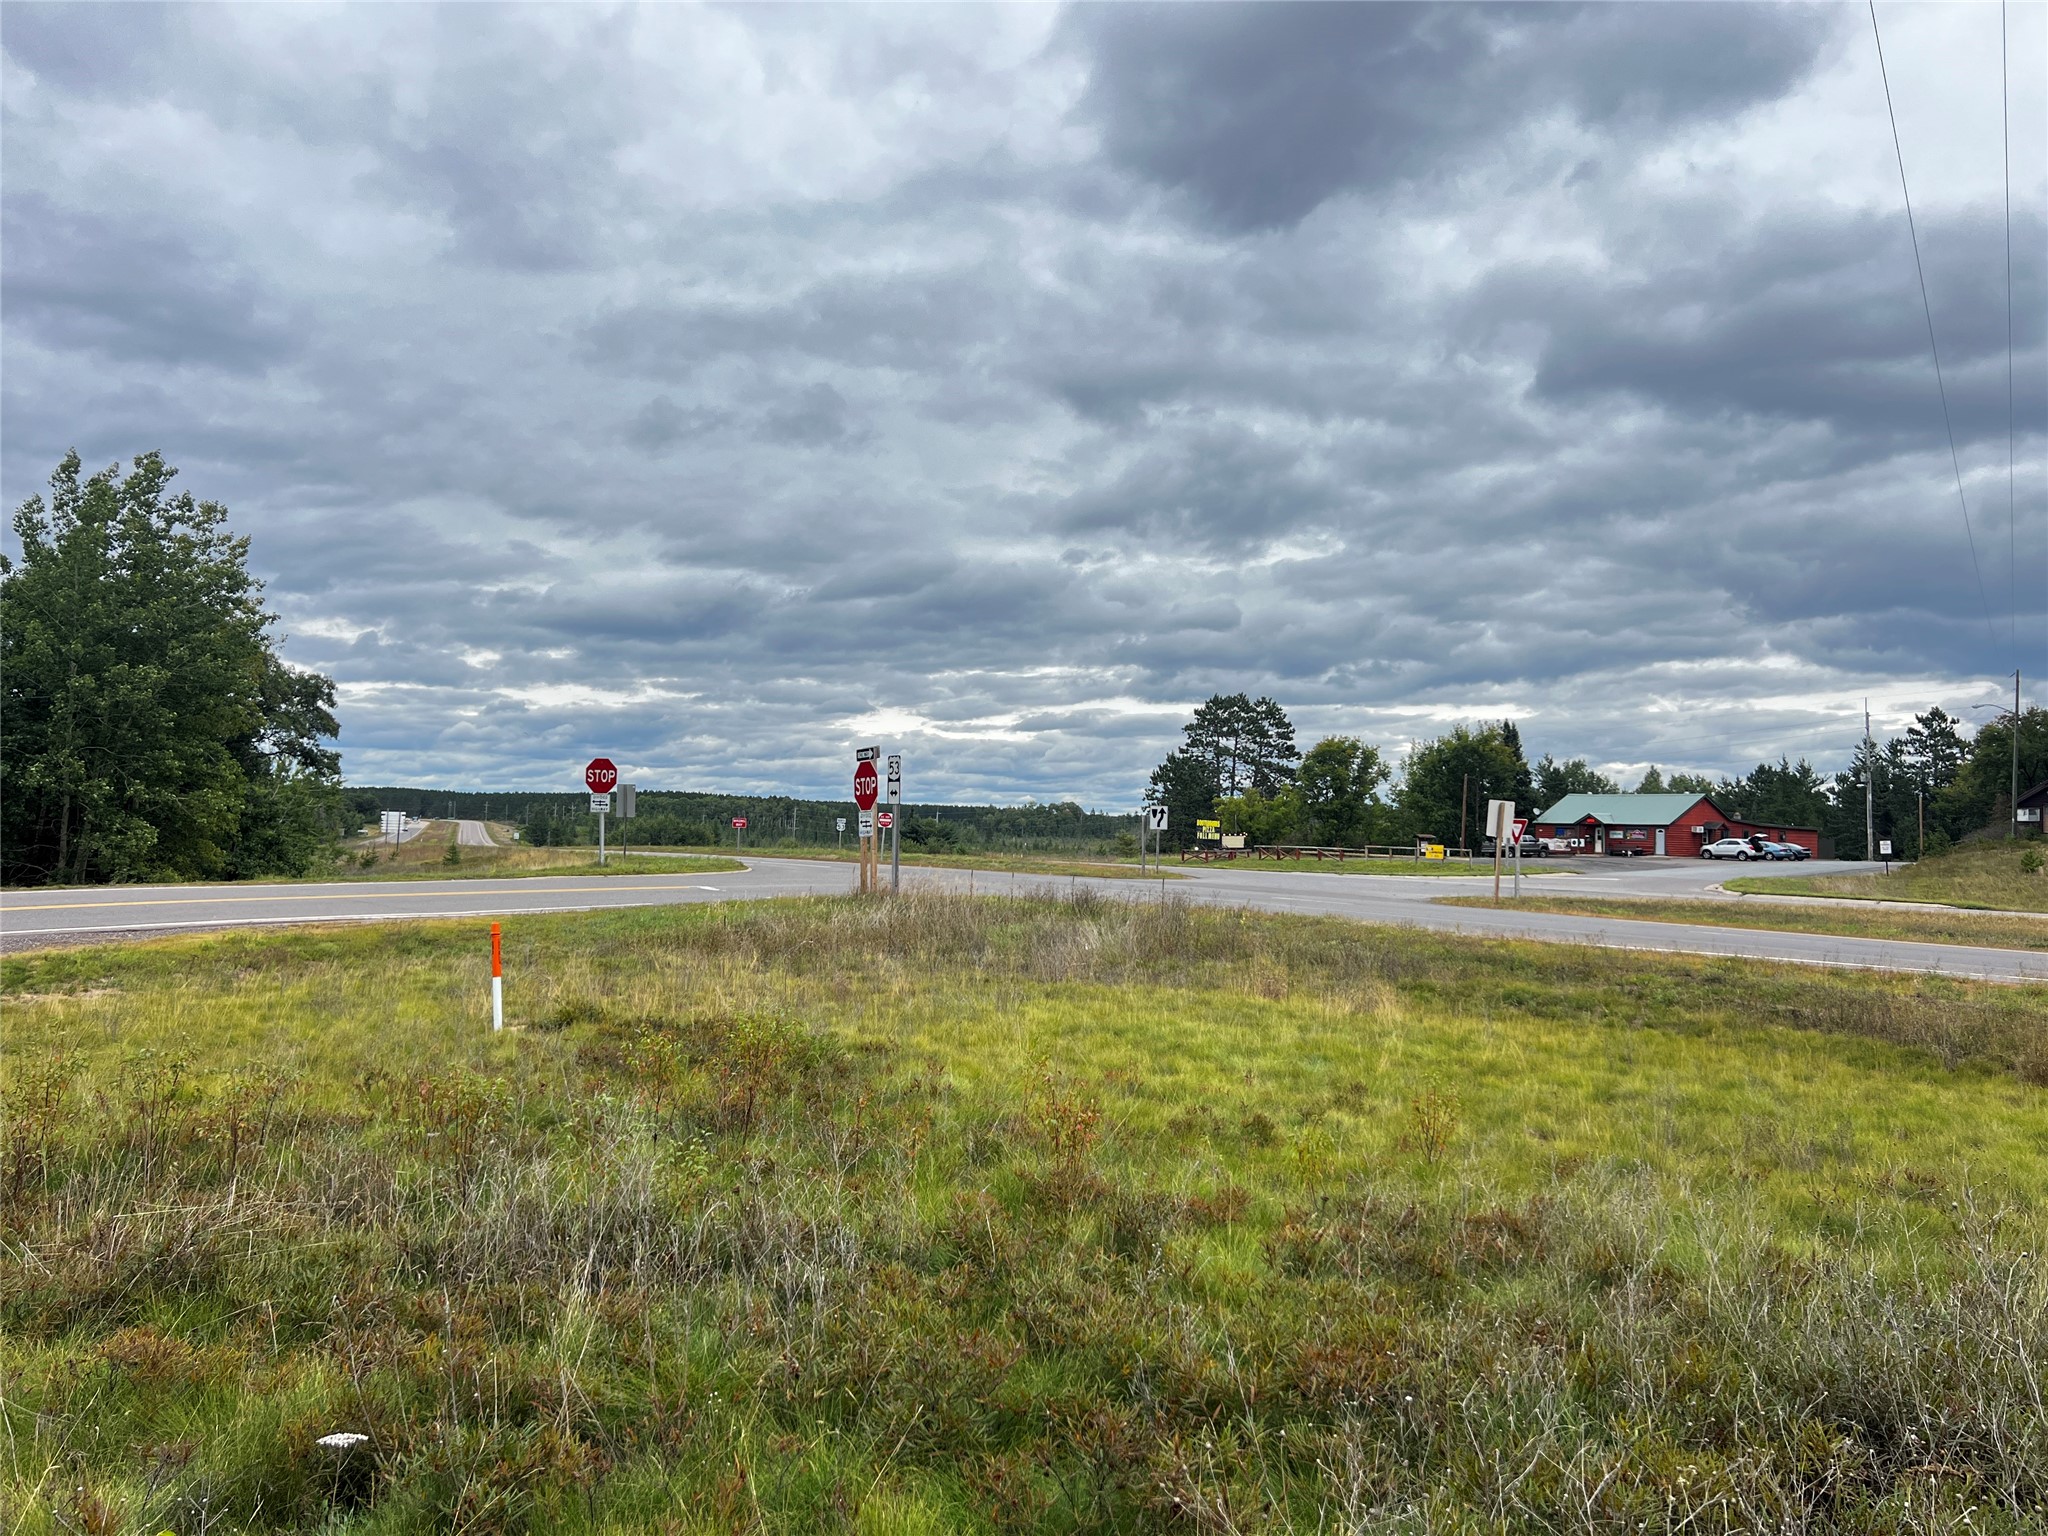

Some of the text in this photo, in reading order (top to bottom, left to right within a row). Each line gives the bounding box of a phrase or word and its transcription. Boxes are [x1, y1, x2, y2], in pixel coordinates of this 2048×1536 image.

[889, 761, 899, 775] 53
[587, 769, 616, 783] STOP
[855, 776, 876, 796] STOP
